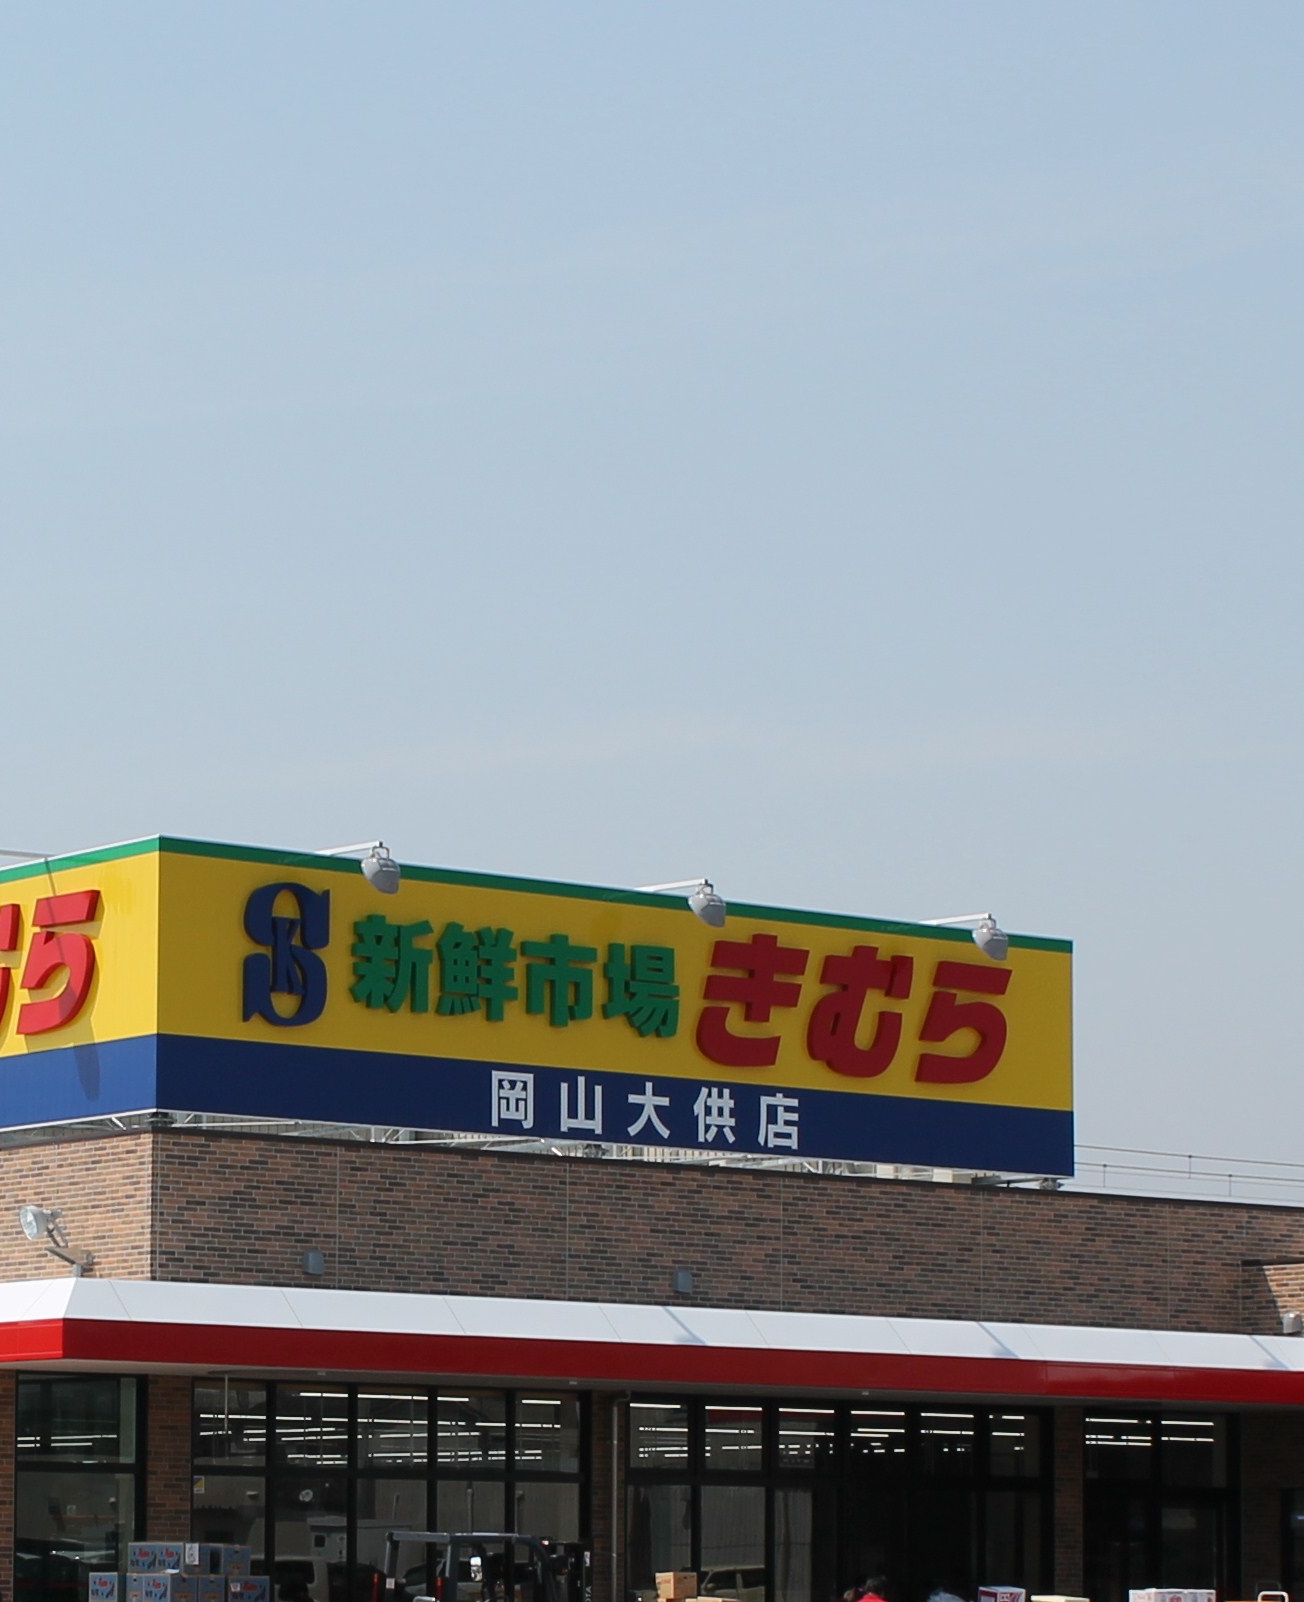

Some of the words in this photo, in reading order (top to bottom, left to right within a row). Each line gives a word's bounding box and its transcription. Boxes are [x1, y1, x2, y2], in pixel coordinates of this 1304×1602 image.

[350, 913, 681, 1039] 新鮮市場
[696, 933, 1014, 1086] きむら
[491, 1069, 802, 1151] 岡山大供店
